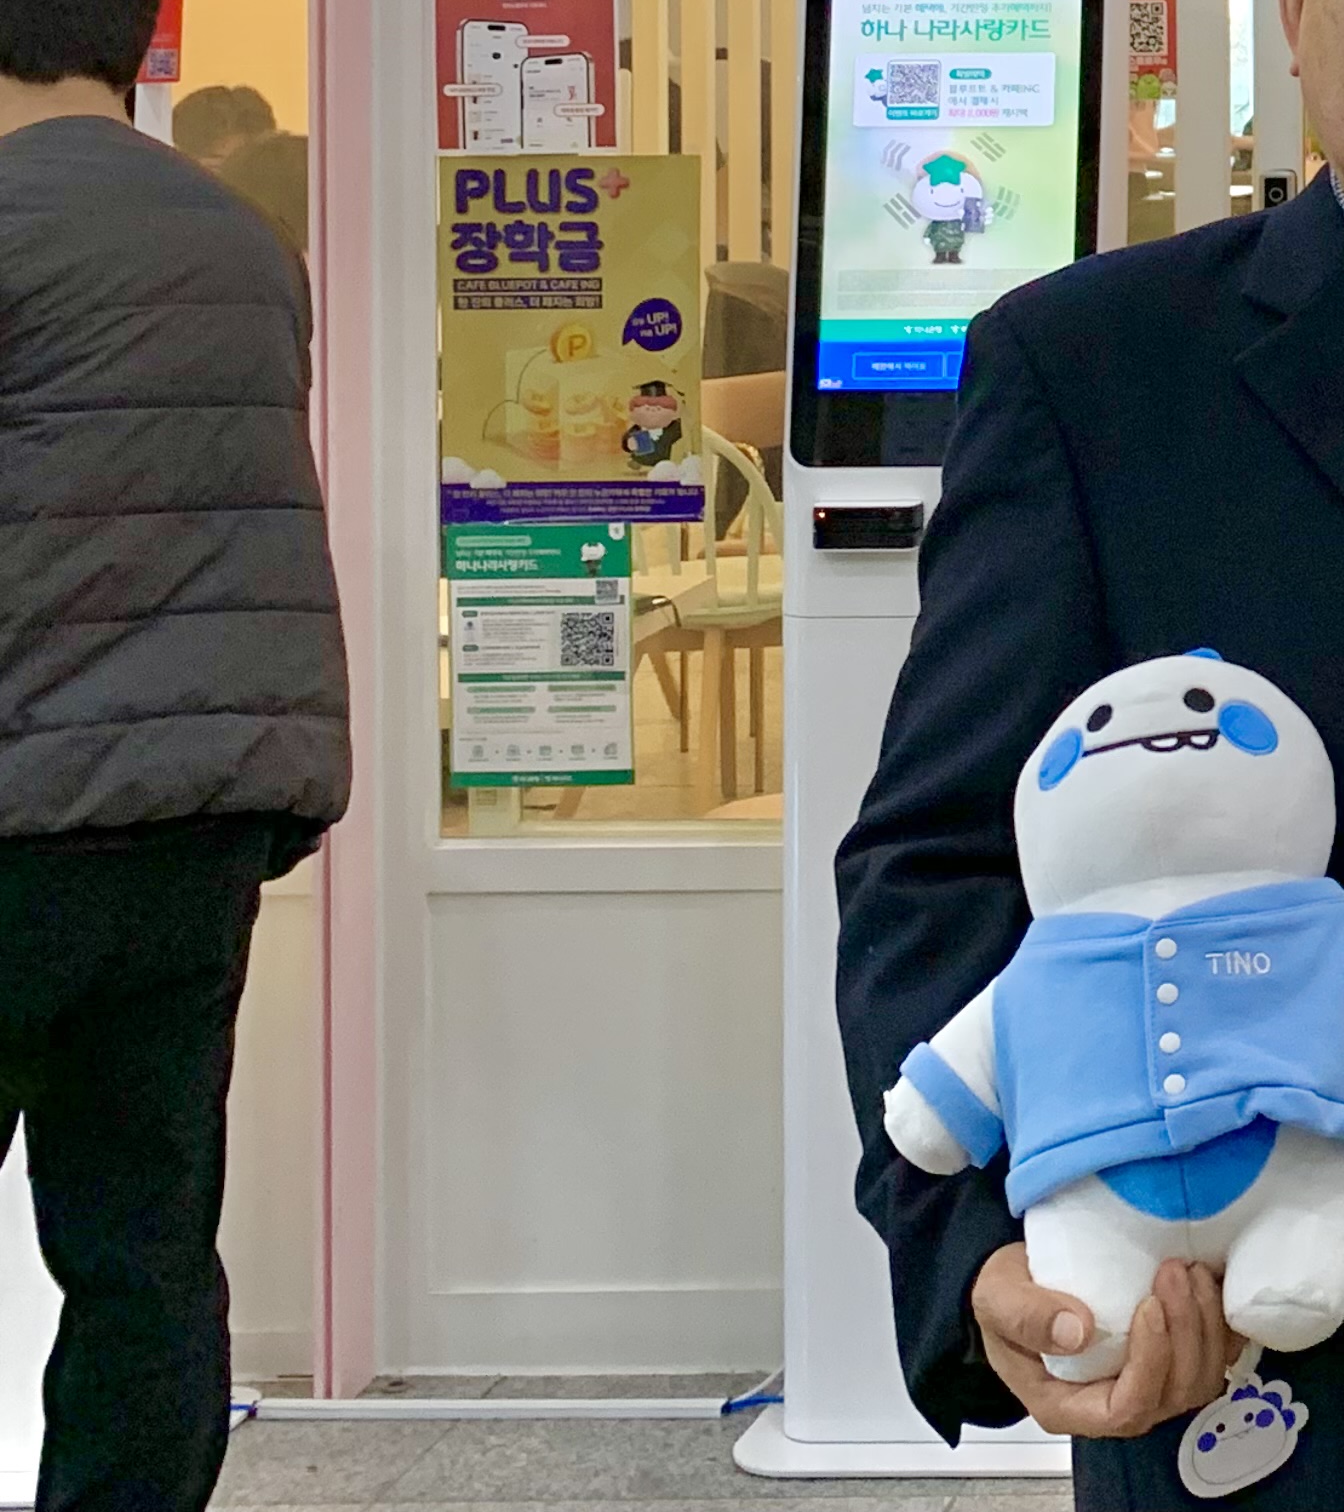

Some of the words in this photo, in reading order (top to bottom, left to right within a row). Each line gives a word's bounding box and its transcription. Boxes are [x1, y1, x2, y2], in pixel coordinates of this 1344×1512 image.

[860, 18, 908, 42] 하나
[914, 18, 1052, 42] 나라사랑카드
[451, 220, 605, 274] 장학금
[1205, 951, 1271, 975] TINO
